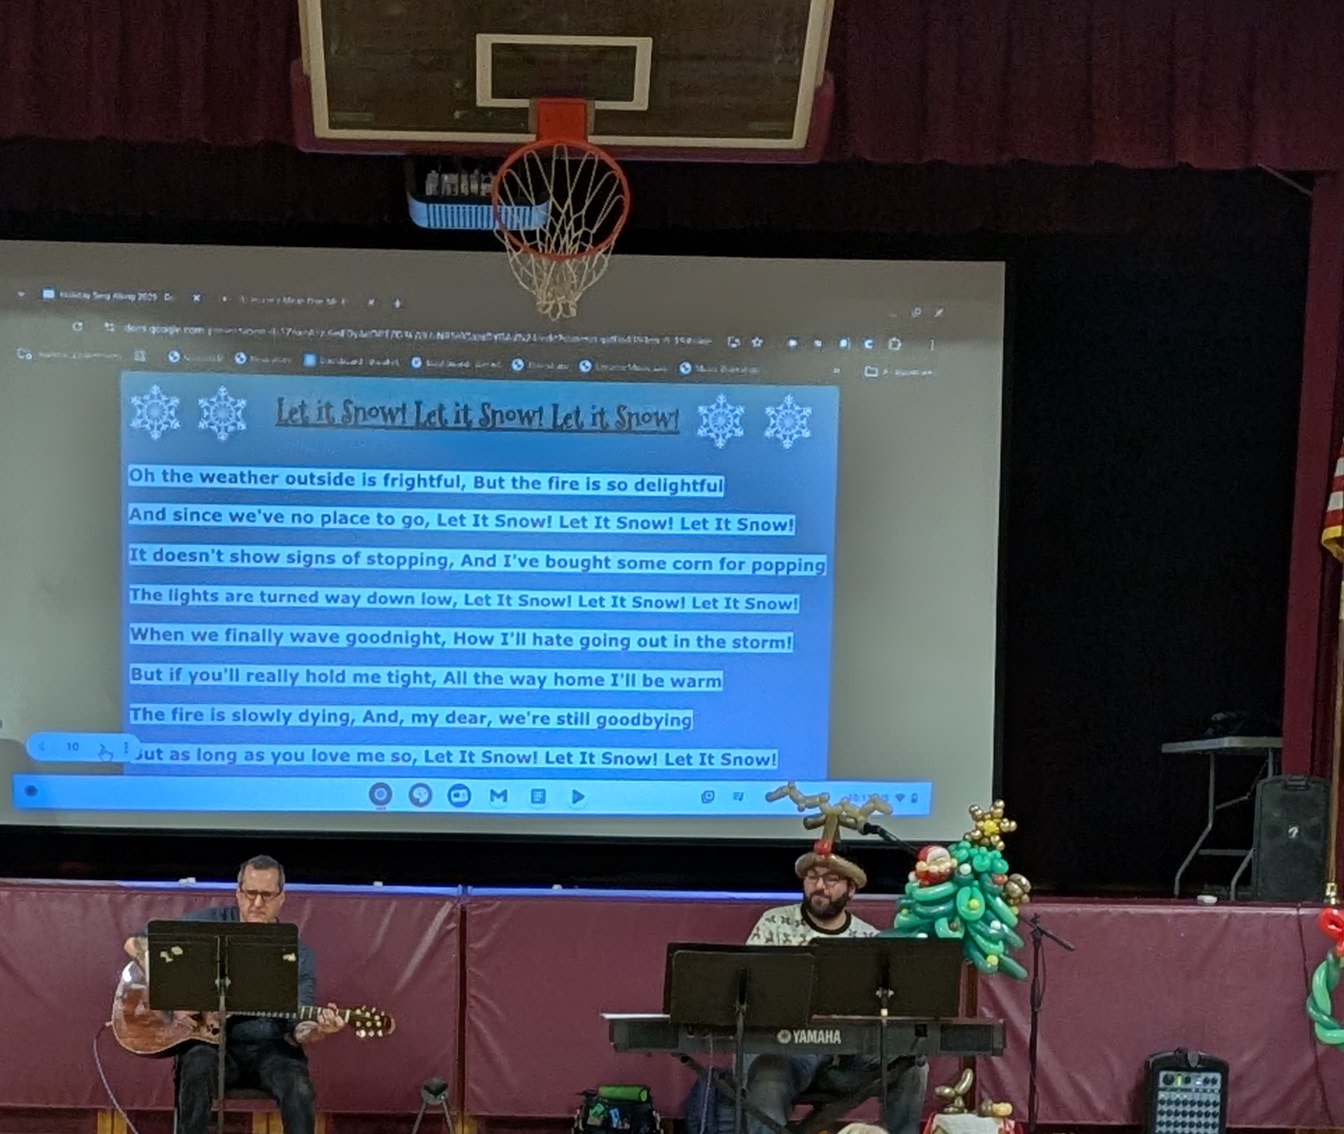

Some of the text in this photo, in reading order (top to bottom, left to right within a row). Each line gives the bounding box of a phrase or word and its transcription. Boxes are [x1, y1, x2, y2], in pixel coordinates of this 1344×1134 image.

[276, 397, 679, 430] Let it Snow! Let it Snow! Let it Snow!
[129, 466, 722, 497] Oh the weather outside is frightful, But the fire is so delightful
[129, 505, 793, 533] And since we've no place to go, Let It Snow! Let It Snow! Let It Snow!
[129, 546, 825, 576] It doesn't show signs of stopping, And I've bought some corn for popping
[129, 585, 798, 614] The lights are turned way down low, Let It Snow! Let It Snow! Let It Snow!
[129, 625, 791, 651] When we finally wave goodnight, How I'll hate going out in the storm!
[129, 665, 721, 689] But if you'll really hold me tight, All the way home I'll be warm
[129, 705, 691, 730] The fire is slowly dying, And, my dear, we're still goodbying
[66, 742, 79, 751] 10
[169, 750, 190, 762] as
[196, 746, 237, 766] long
[243, 751, 265, 763] as
[270, 751, 304, 766] you
[311, 748, 350, 764] love
[356, 752, 385, 764] me
[390, 752, 418, 767] so,
[424, 749, 453, 765] Let
[458, 749, 475, 765] It
[481, 749, 538, 766] Snow!
[544, 750, 573, 766] Let
[579, 750, 595, 766] It
[601, 751, 657, 767] Snow!
[664, 751, 693, 767] Let
[698, 752, 715, 768] It
[720, 752, 776, 768] Snow!
[793, 1029, 841, 1045] YAMAHA
